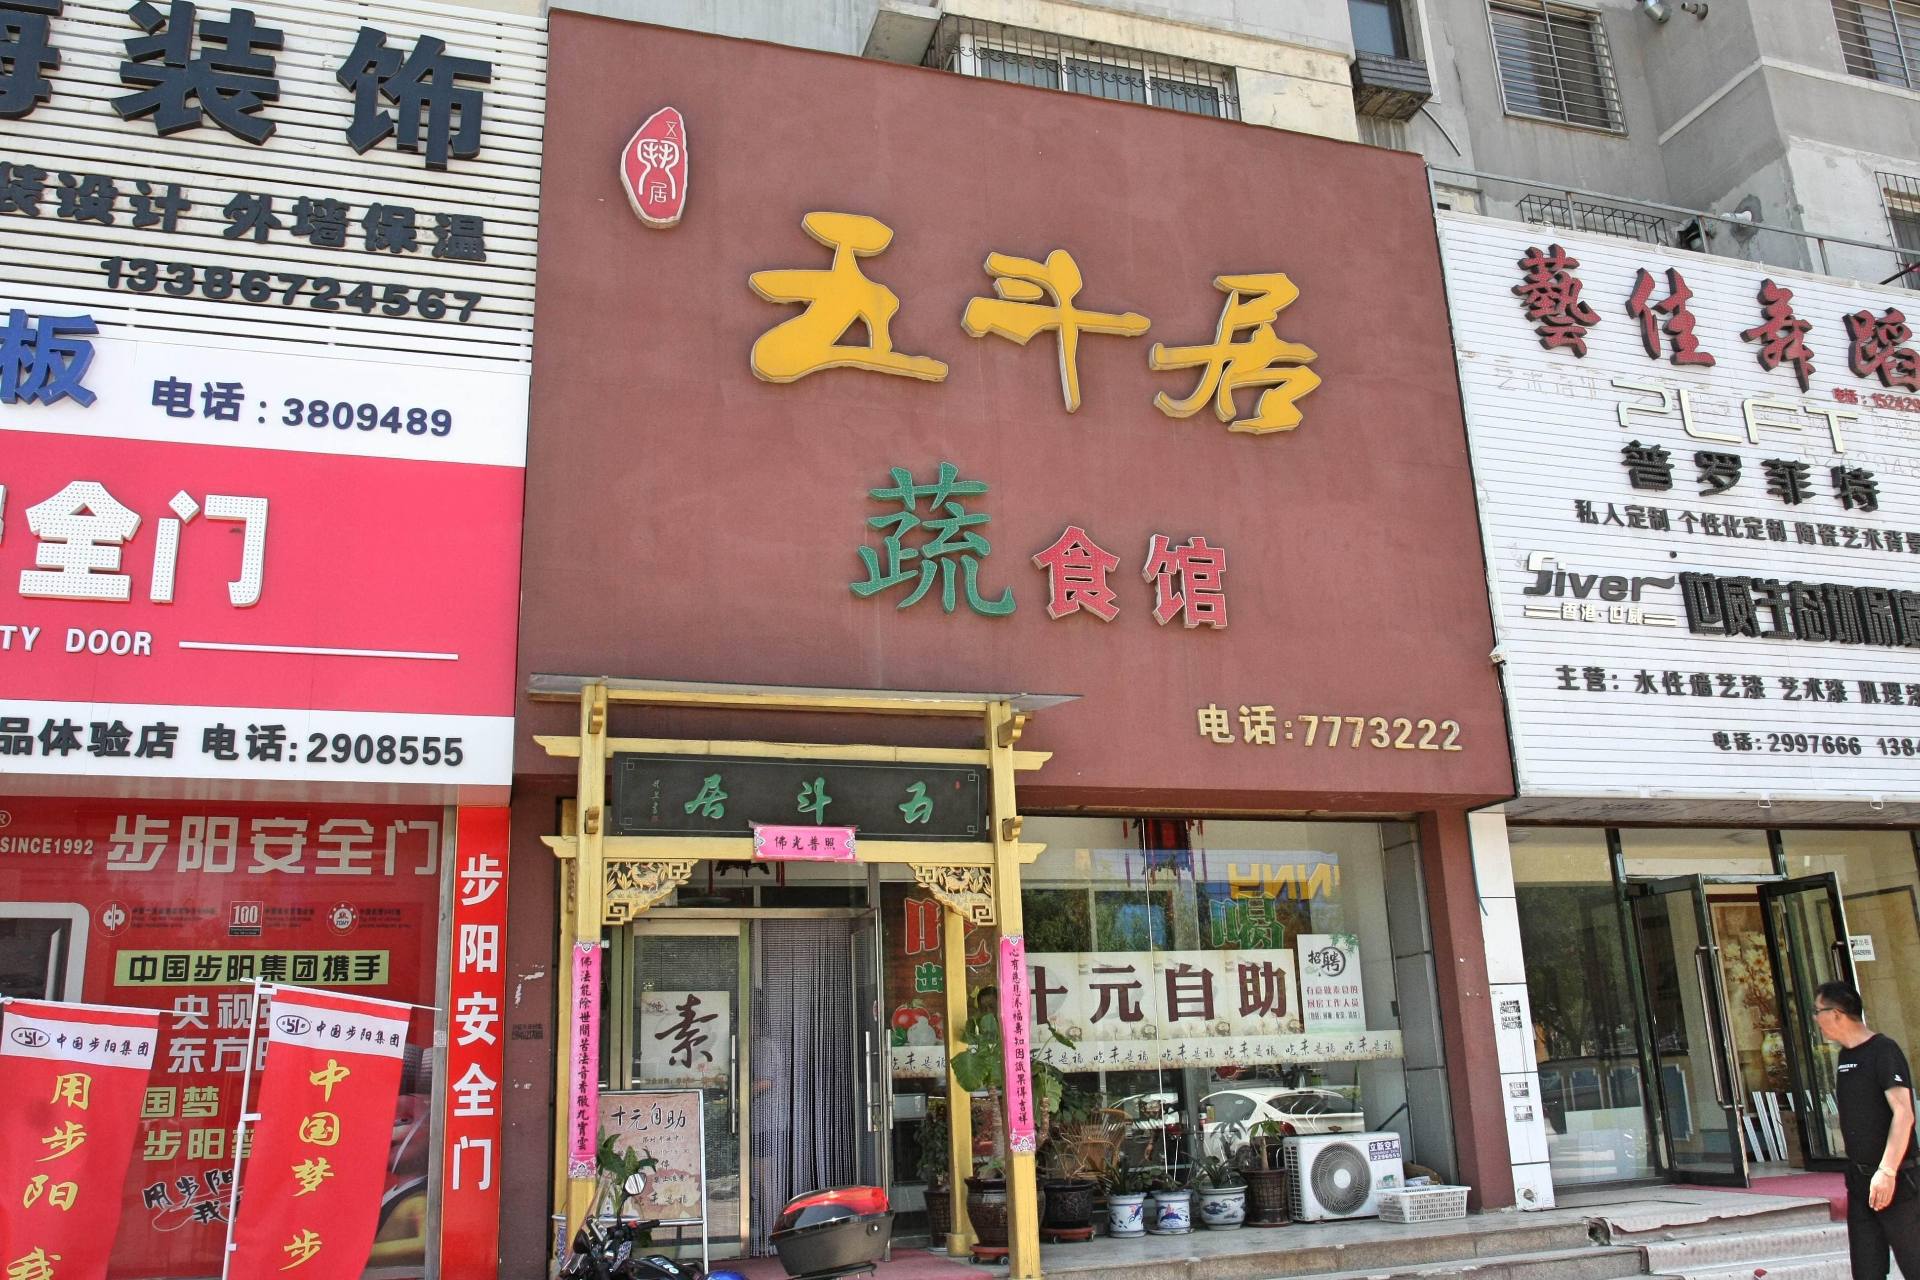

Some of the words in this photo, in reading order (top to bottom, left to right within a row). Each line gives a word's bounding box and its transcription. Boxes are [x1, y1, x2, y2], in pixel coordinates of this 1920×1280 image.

[223, 190, 487, 262] 外墙保温
[101, 256, 482, 323] 13386724567
[1621, 439, 1880, 512] 普罗菲特
[0, 479, 270, 608] 全门
[850, 461, 1229, 630] 蔬食馆
[1574, 499, 1671, 532] 私人定制
[1678, 510, 1787, 543] 个性化定制
[65, 628, 153, 656] DOOR
[1778, 676, 1848, 704] 艺术漆
[0, 716, 179, 759] 品体验店
[107, 814, 439, 876] 步阳安全门
[774, 835, 836, 852] 佛光普照
[129, 954, 381, 982] 中国步阳集团携手
[1307, 949, 1340, 972] 招聘
[452, 853, 502, 1190] 步阳安全门
[1028, 959, 1288, 1026] 十元自助
